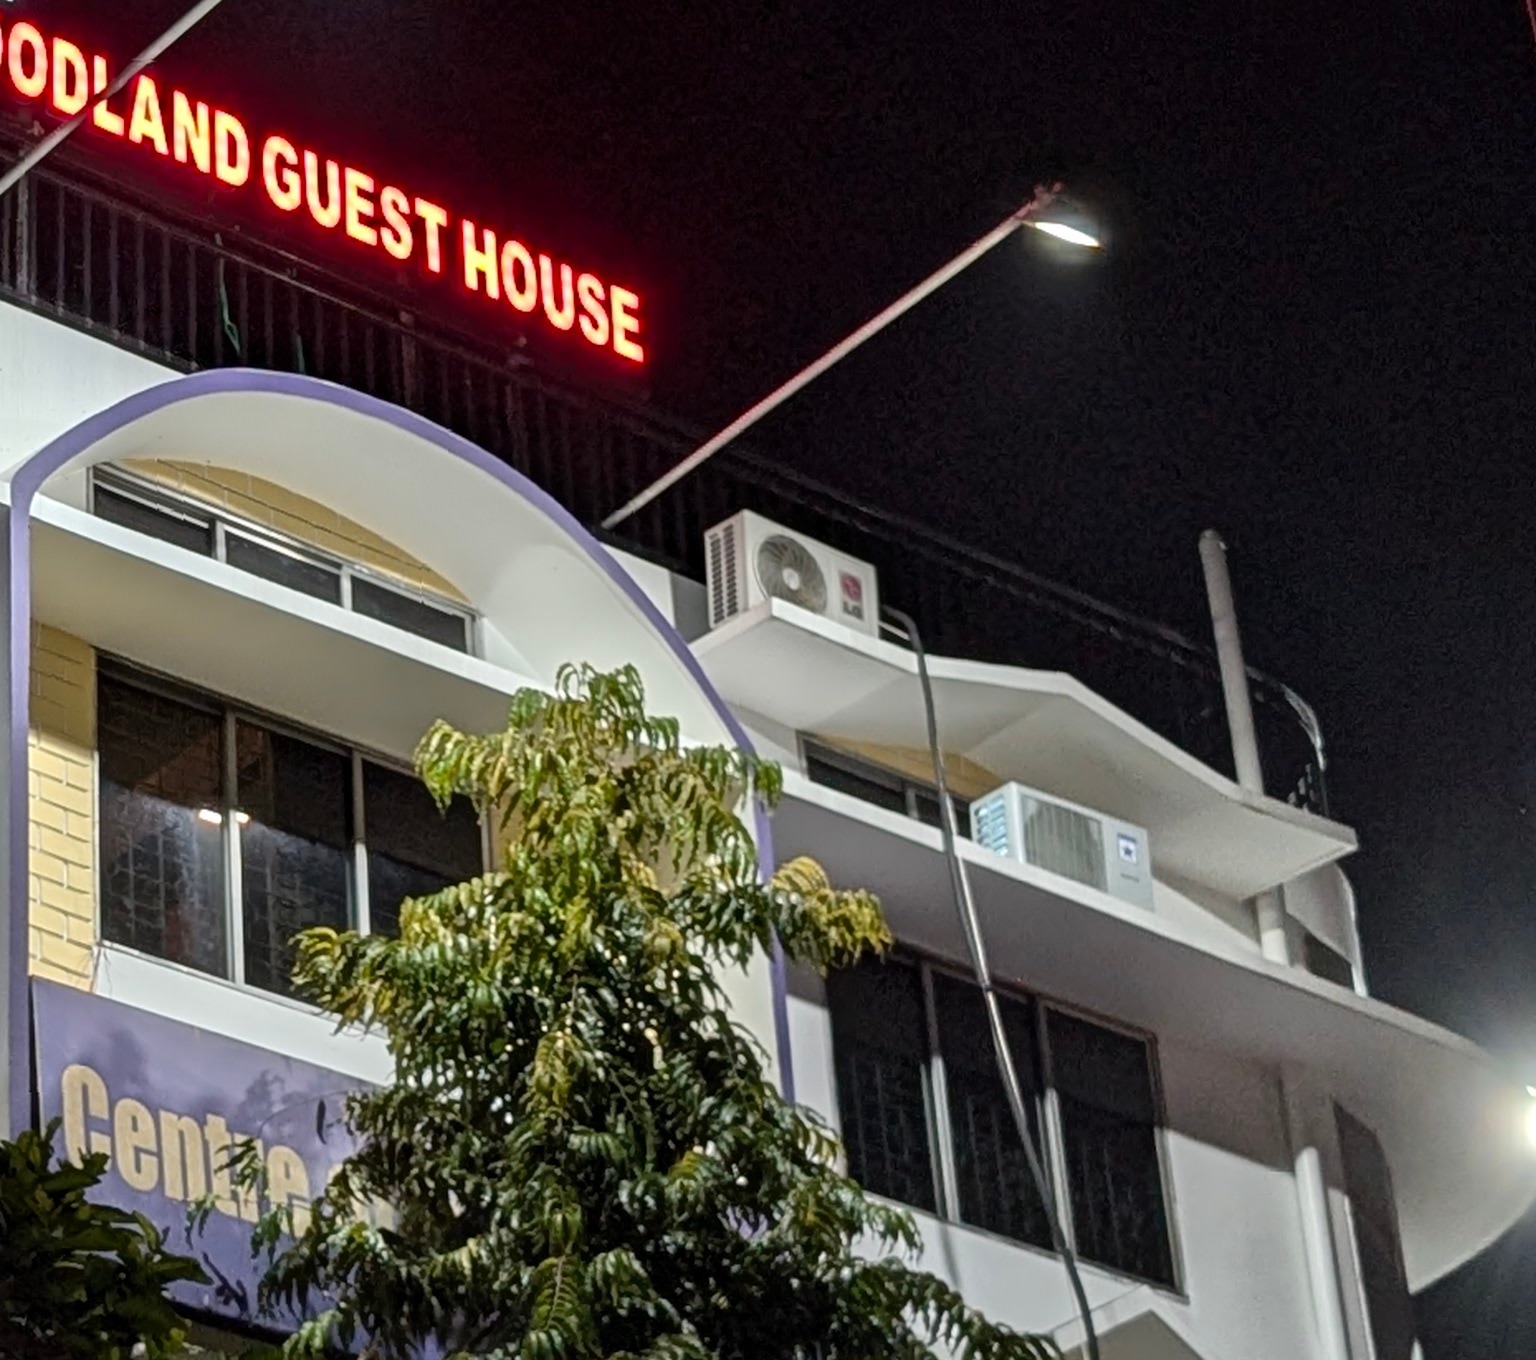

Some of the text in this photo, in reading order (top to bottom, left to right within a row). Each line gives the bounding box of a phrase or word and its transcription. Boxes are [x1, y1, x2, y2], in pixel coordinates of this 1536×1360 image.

[263, 135, 447, 273] GUEST
[463, 218, 644, 363] HOUSE
[61, 1063, 312, 1241] Centre
